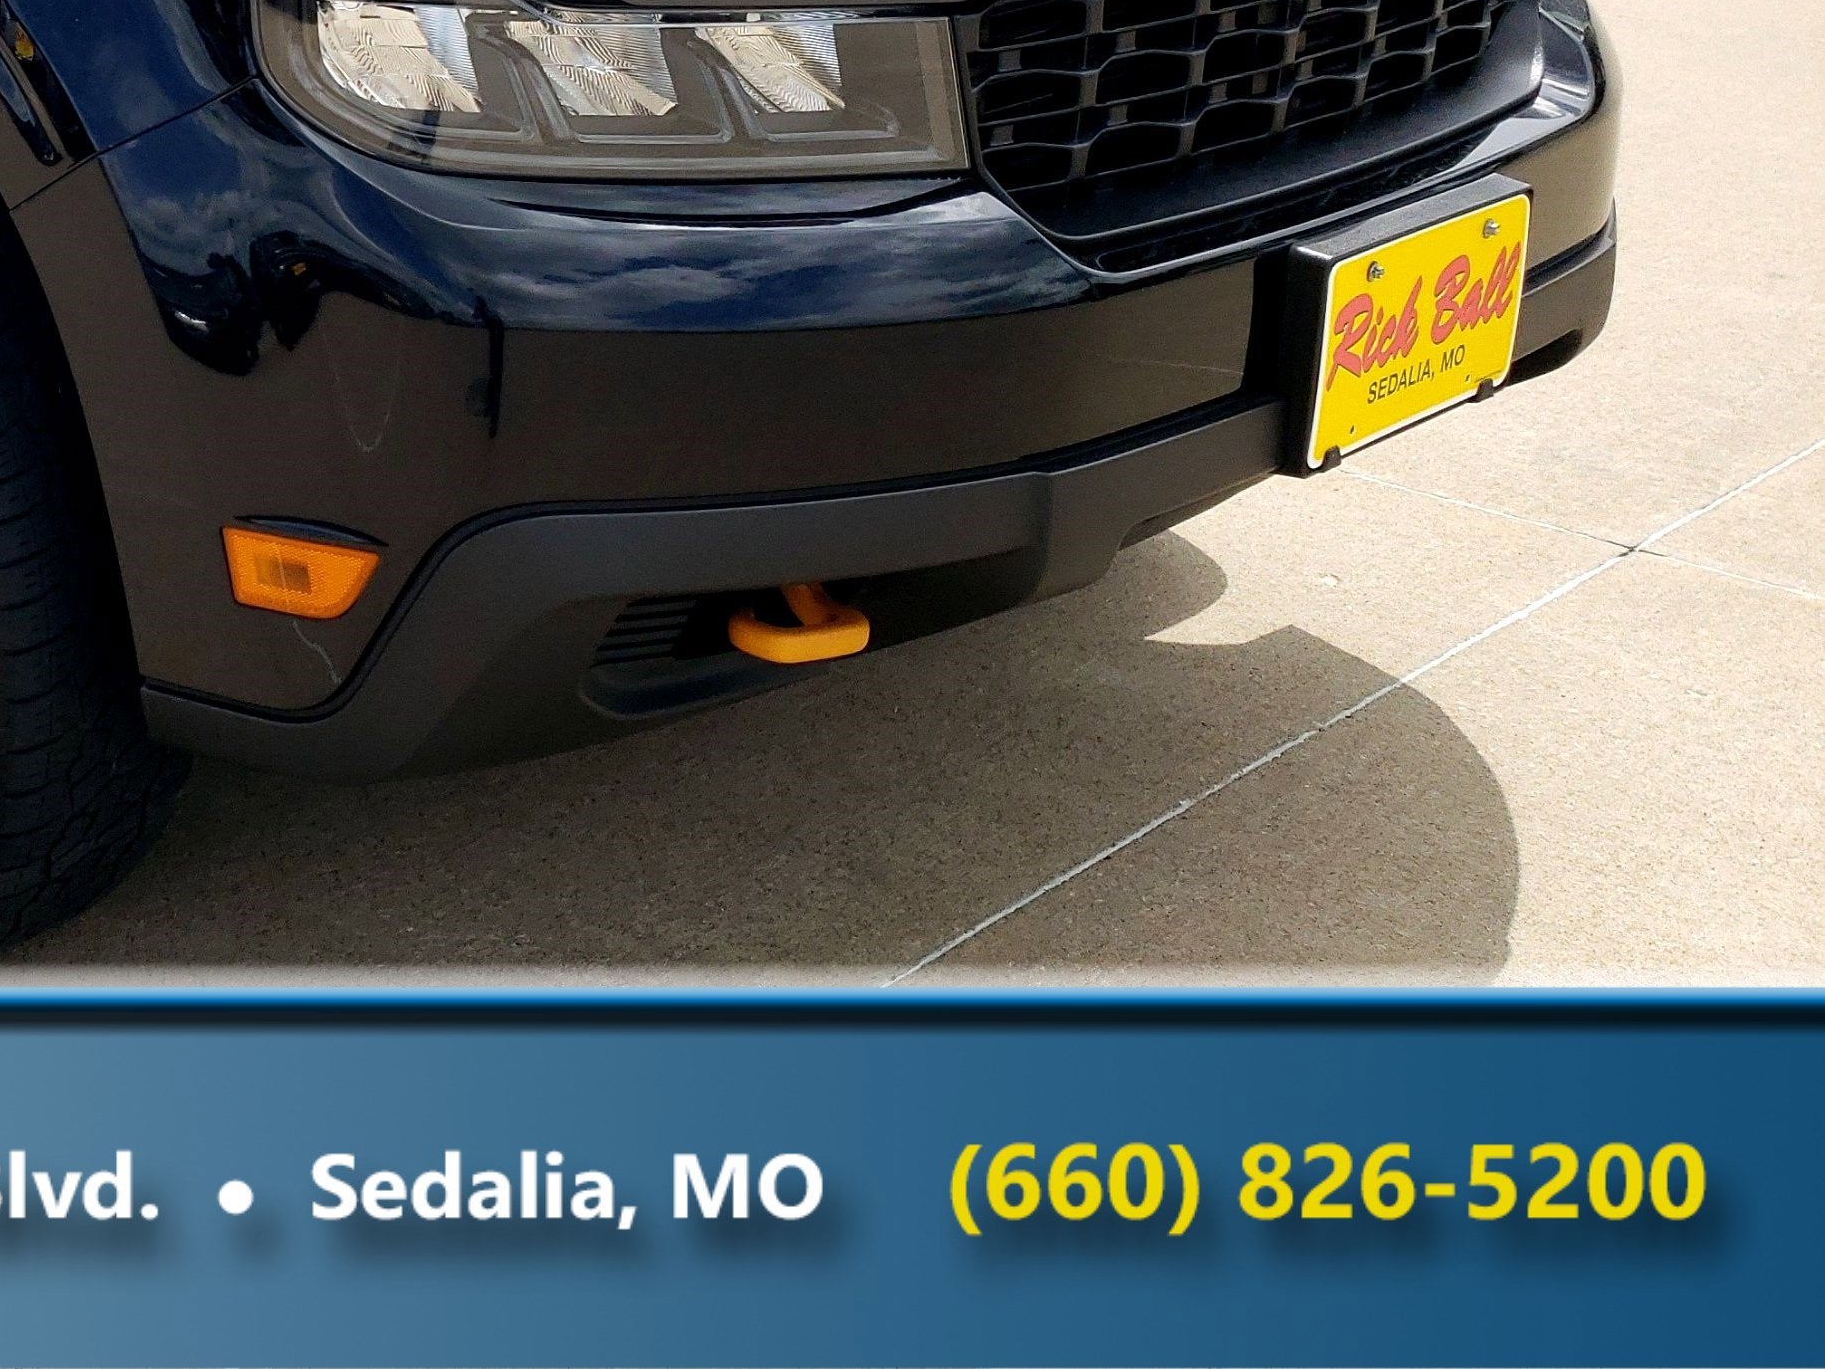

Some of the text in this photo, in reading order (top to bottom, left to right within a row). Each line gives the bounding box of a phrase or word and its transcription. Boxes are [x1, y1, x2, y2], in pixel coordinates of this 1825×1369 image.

[1325, 242, 1521, 391] Rick Ball
[1367, 344, 1466, 404] SEDALIA, MO
